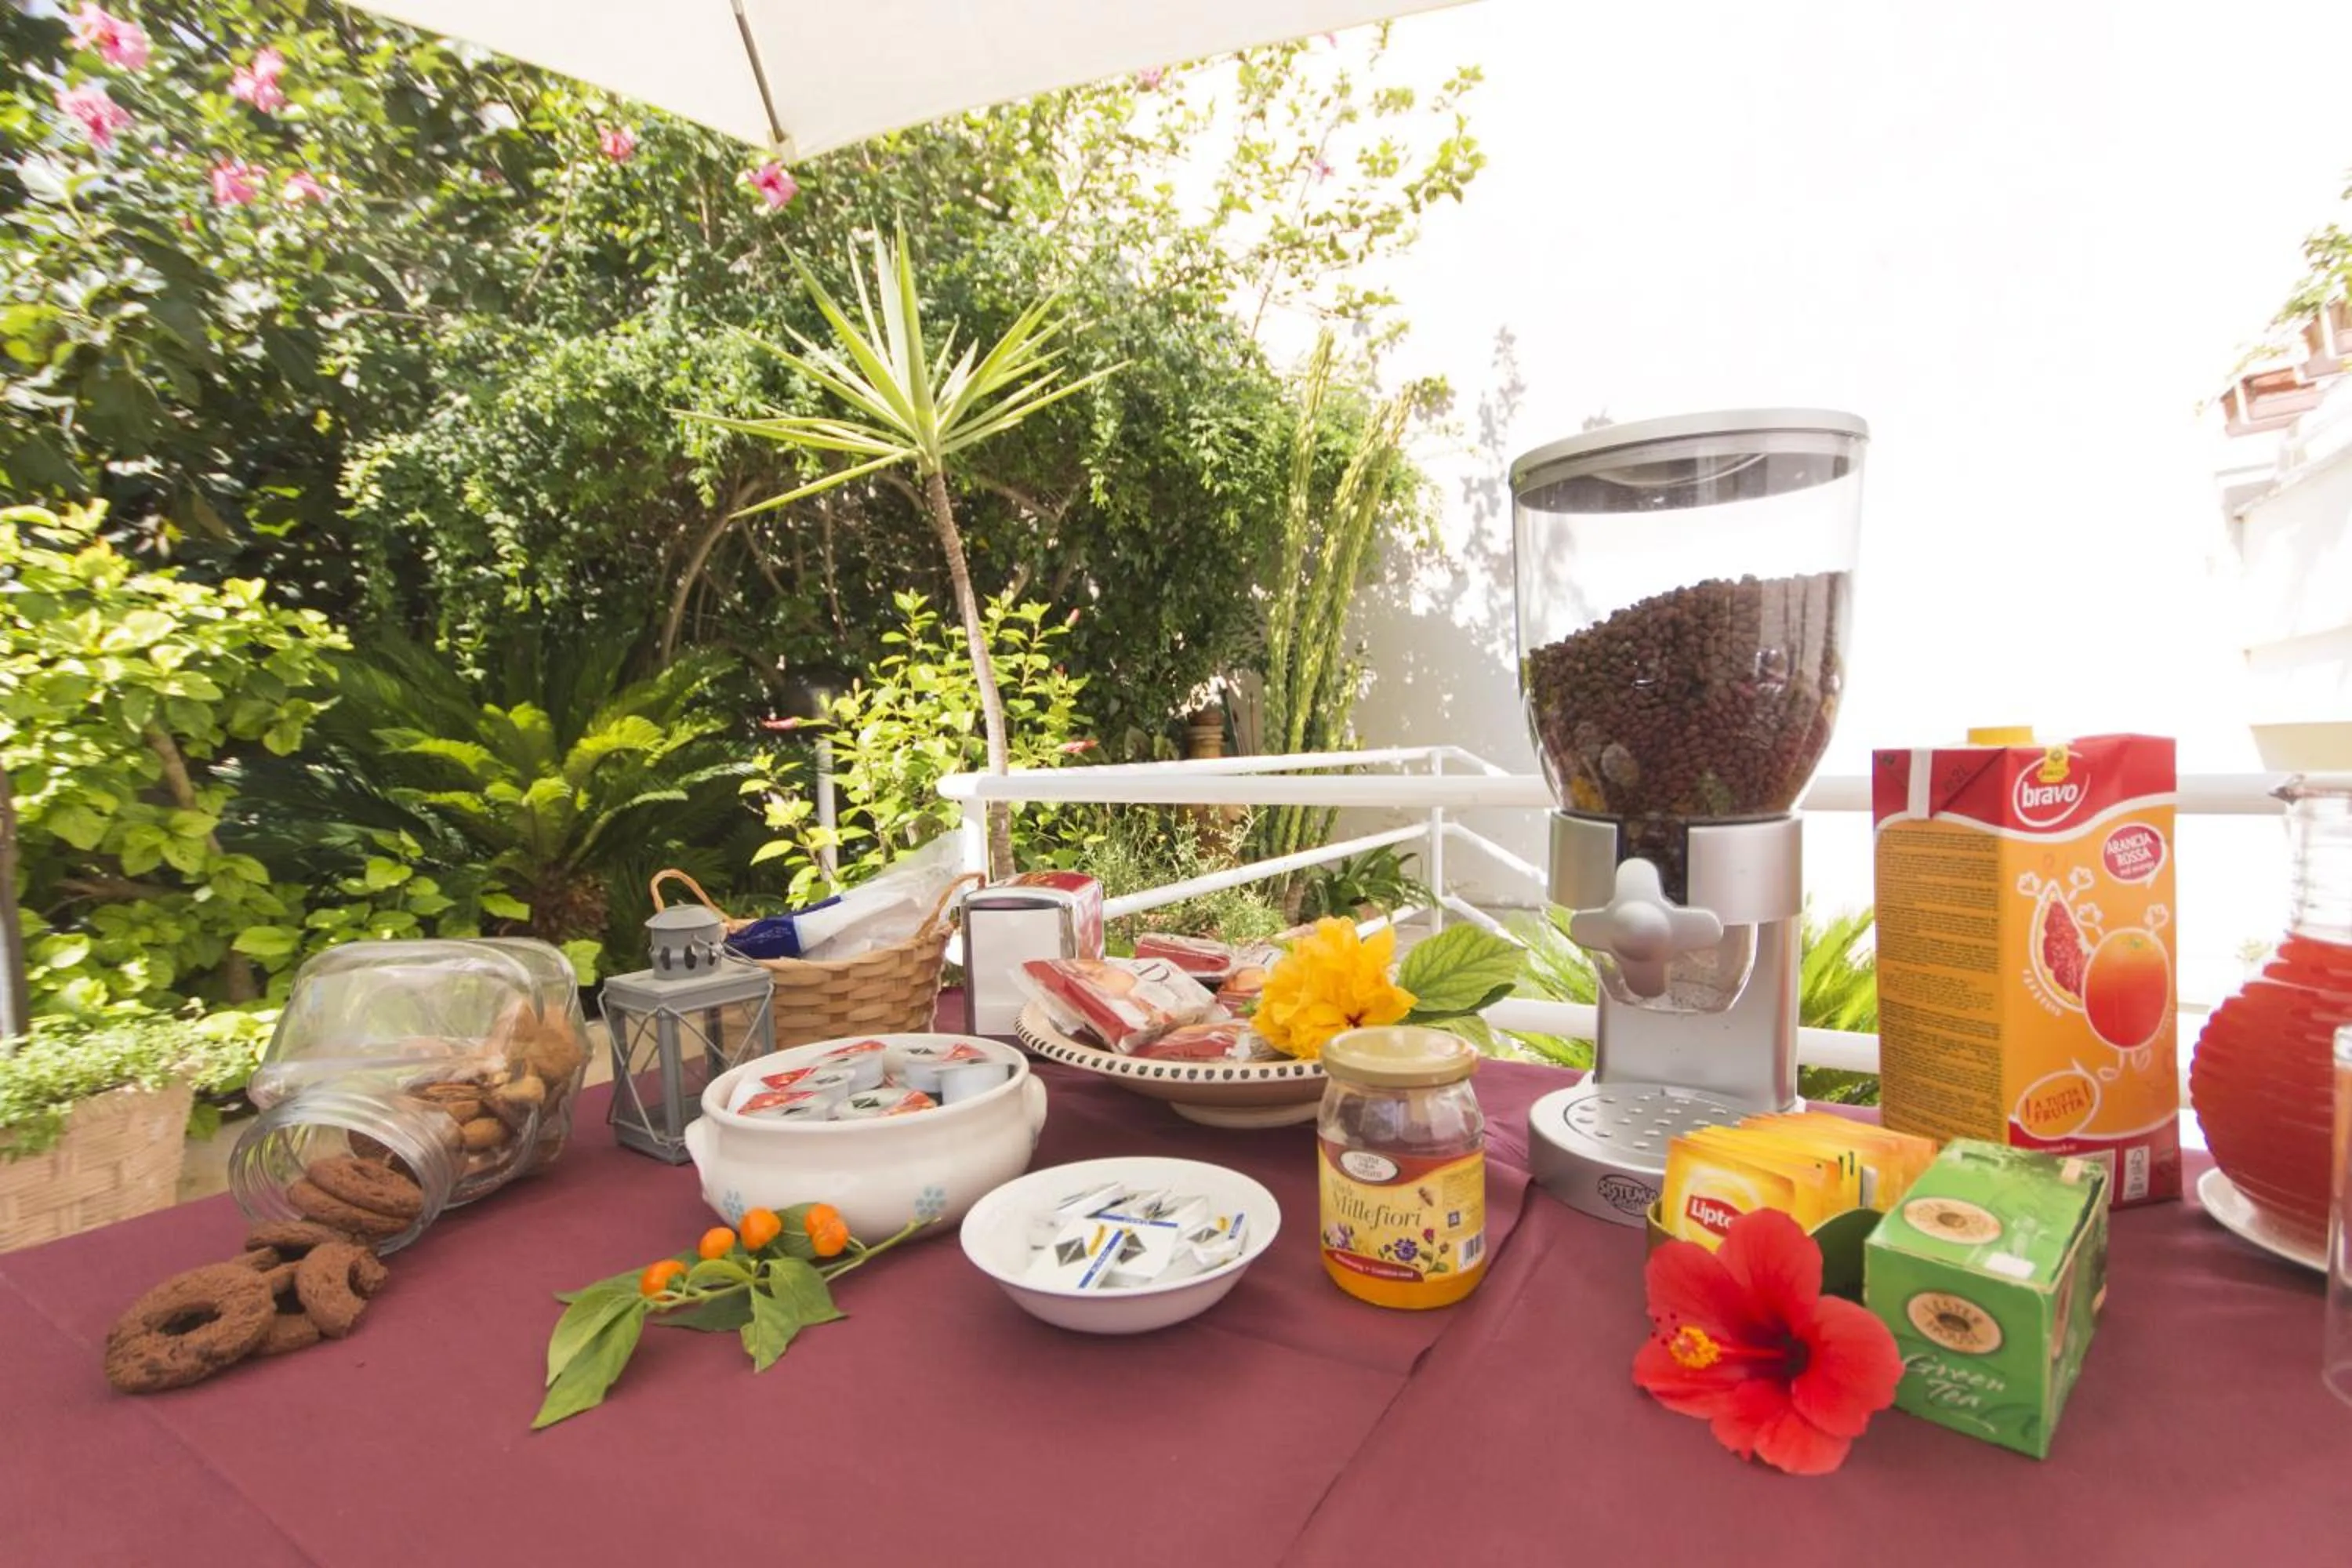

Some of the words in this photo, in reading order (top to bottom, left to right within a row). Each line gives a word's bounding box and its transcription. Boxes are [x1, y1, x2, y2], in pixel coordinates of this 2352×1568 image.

[2021, 781, 2078, 808] bravo
[2106, 832, 2154, 855] ARANCIA
[2115, 847, 2152, 866] ROSSA
[1334, 1191, 1423, 1230] Millefiori
[1690, 1198, 1733, 1229] Lipto
[1903, 1352, 2005, 1392] Green
[1926, 1377, 1981, 1409] Tea
